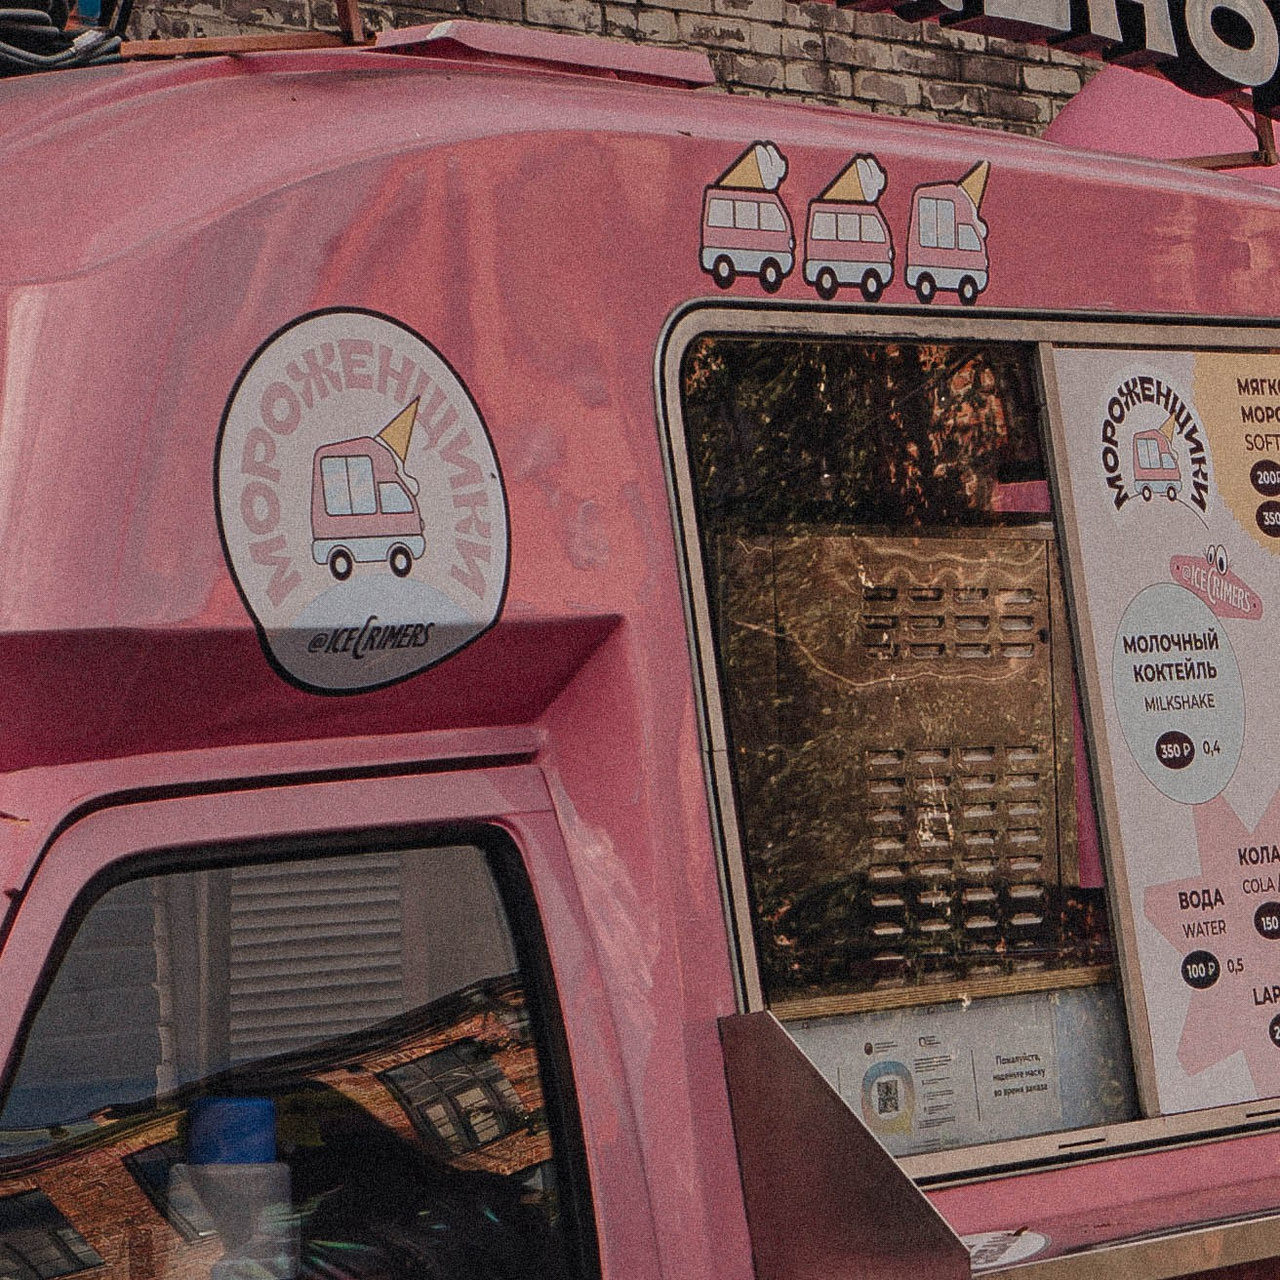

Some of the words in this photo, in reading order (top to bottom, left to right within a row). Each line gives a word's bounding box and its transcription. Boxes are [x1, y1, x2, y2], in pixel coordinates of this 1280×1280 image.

[1102, 376, 1209, 513] МОРОЖЕНЩИКИ
[1244, 434, 1280, 451] SOFT
[308, 615, 436, 660] @ICECRIMERS
[1123, 627, 1219, 654] МОЛОЧНЫЙ
[1133, 657, 1218, 683] КОКТЕЙЛЬ
[1144, 693, 1216, 712] MILKSHAKE
[1202, 739, 1221, 757] 0,4
[1242, 876, 1276, 895] COLA
[1178, 888, 1226, 911] ВОДА
[1182, 919, 1228, 939] WATER
[1226, 958, 1245, 976] 0,5
